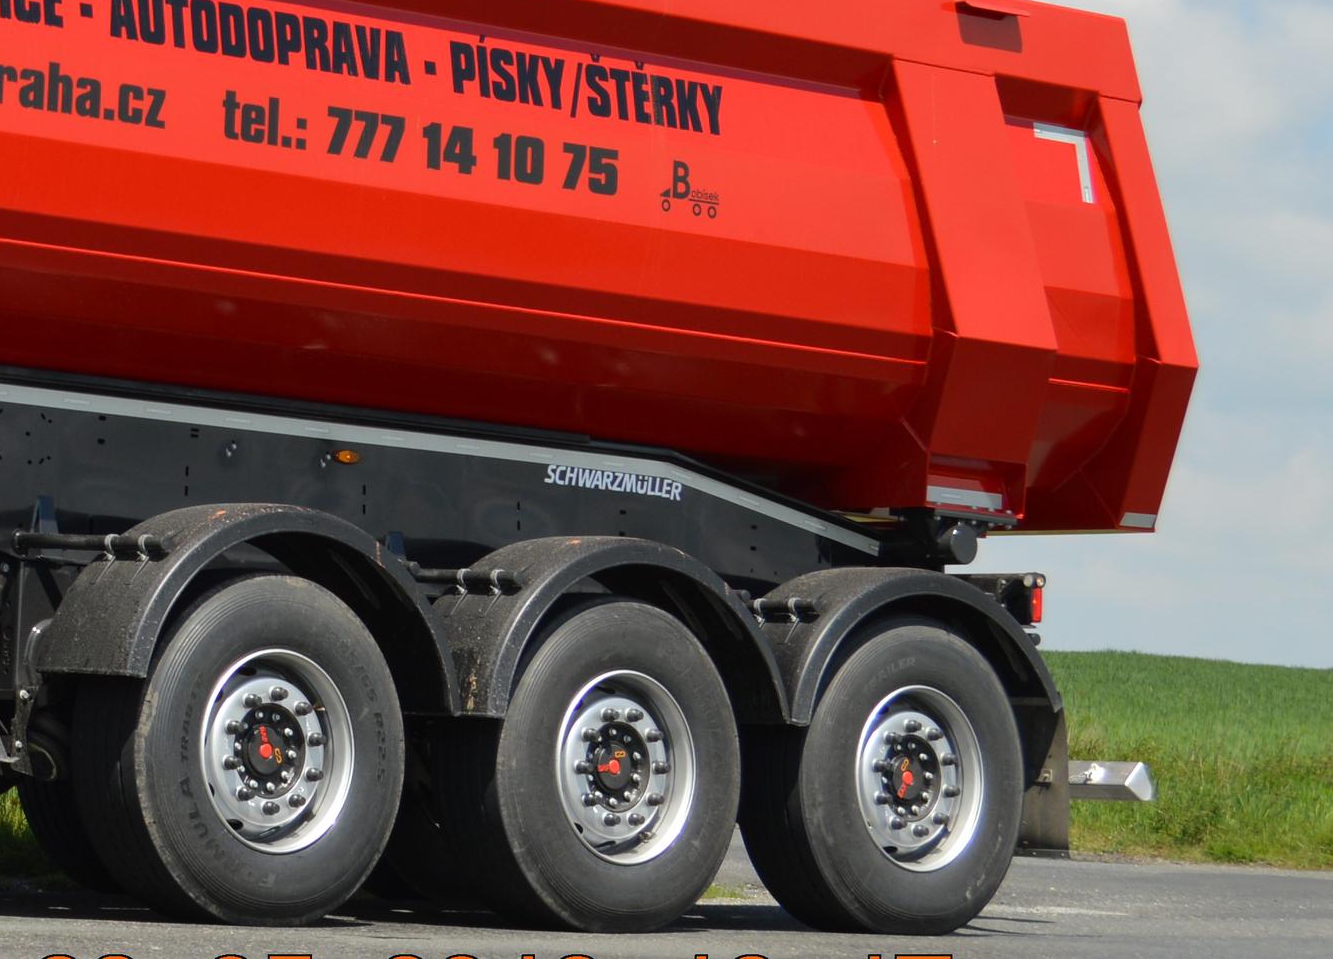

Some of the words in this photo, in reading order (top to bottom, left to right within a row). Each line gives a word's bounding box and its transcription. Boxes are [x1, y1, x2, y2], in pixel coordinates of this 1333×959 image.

[224, 91, 307, 150] tel.:
[328, 107, 406, 163] 777
[423, 123, 477, 175] 14
[494, 133, 545, 185] 10
[564, 143, 619, 196] 75
